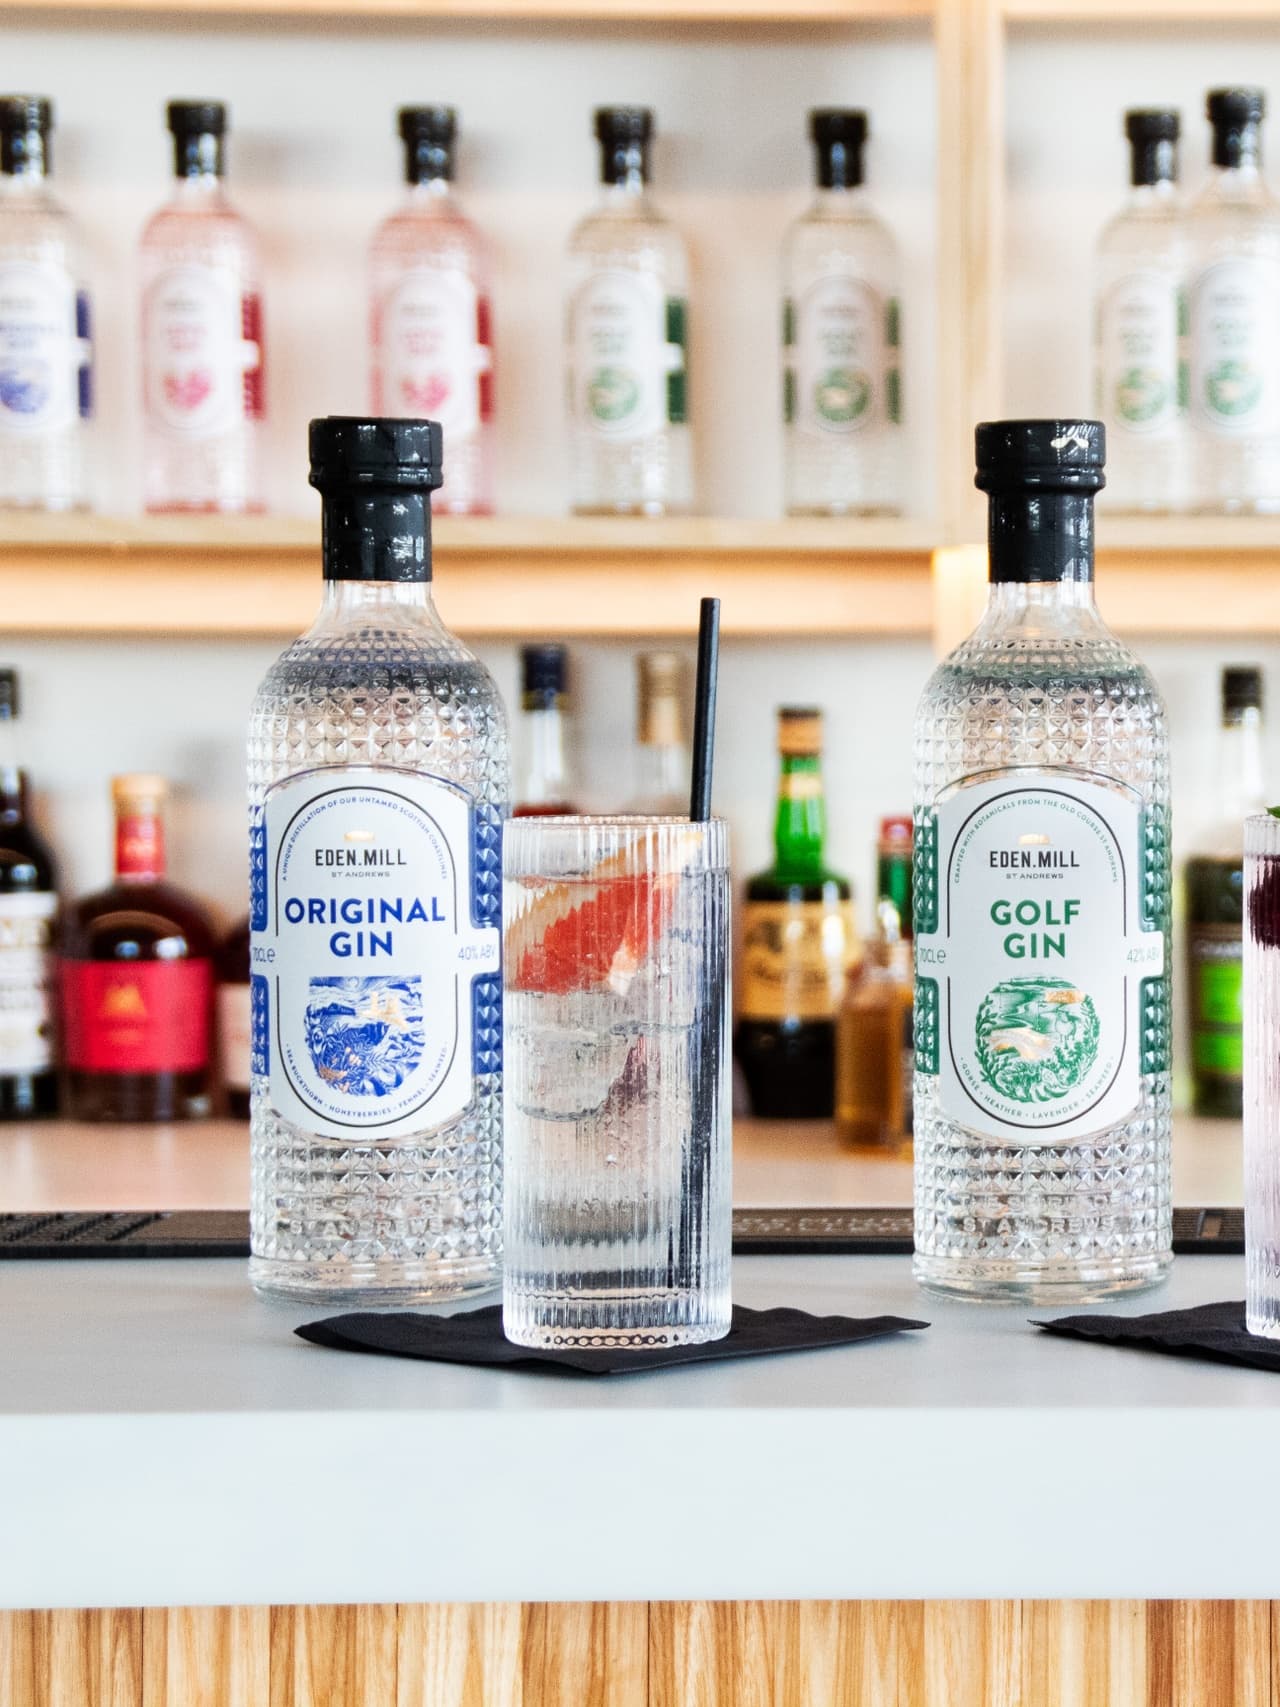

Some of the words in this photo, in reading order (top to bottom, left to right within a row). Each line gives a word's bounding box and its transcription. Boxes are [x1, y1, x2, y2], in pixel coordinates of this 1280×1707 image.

[282, 843, 293, 873] UNIQUE
[290, 805, 326, 843] DISTILLATION
[327, 800, 338, 808] OF
[339, 796, 357, 804] OUR
[359, 796, 398, 810] UNTAMED
[399, 807, 430, 834] SCOTTISH
[954, 848, 966, 883] CRAFTED
[963, 829, 975, 847] WITH
[974, 801, 1016, 830] BOTANICALS
[1017, 798, 1040, 806] FROM
[1043, 799, 1058, 807] THE
[1060, 803, 1076, 814] OLD
[1077, 811, 1101, 834] COURSE
[1105, 845, 1118, 883] ANDREWS
[315, 848, 408, 867] EDEN.MILL
[989, 850, 1081, 868] EDEN.MILL
[284, 896, 446, 925] ORIGINAL
[989, 899, 1081, 926] GOLF
[329, 930, 393, 958] GIN
[1003, 932, 1066, 959] GIN
[291, 1065, 323, 1104] BUCKTHORN
[329, 1105, 392, 1117] HONEYBERRIES
[398, 1088, 426, 1108] FENNEL
[962, 1063, 980, 1091] GORSE
[984, 1095, 1022, 1116] HEATHER
[1032, 1101, 1080, 1119] LAVENDER
[1086, 1061, 1112, 1098] SEAWEED
[962, 1217, 992, 1233] ST
[996, 1217, 1115, 1234] ANDREWS
